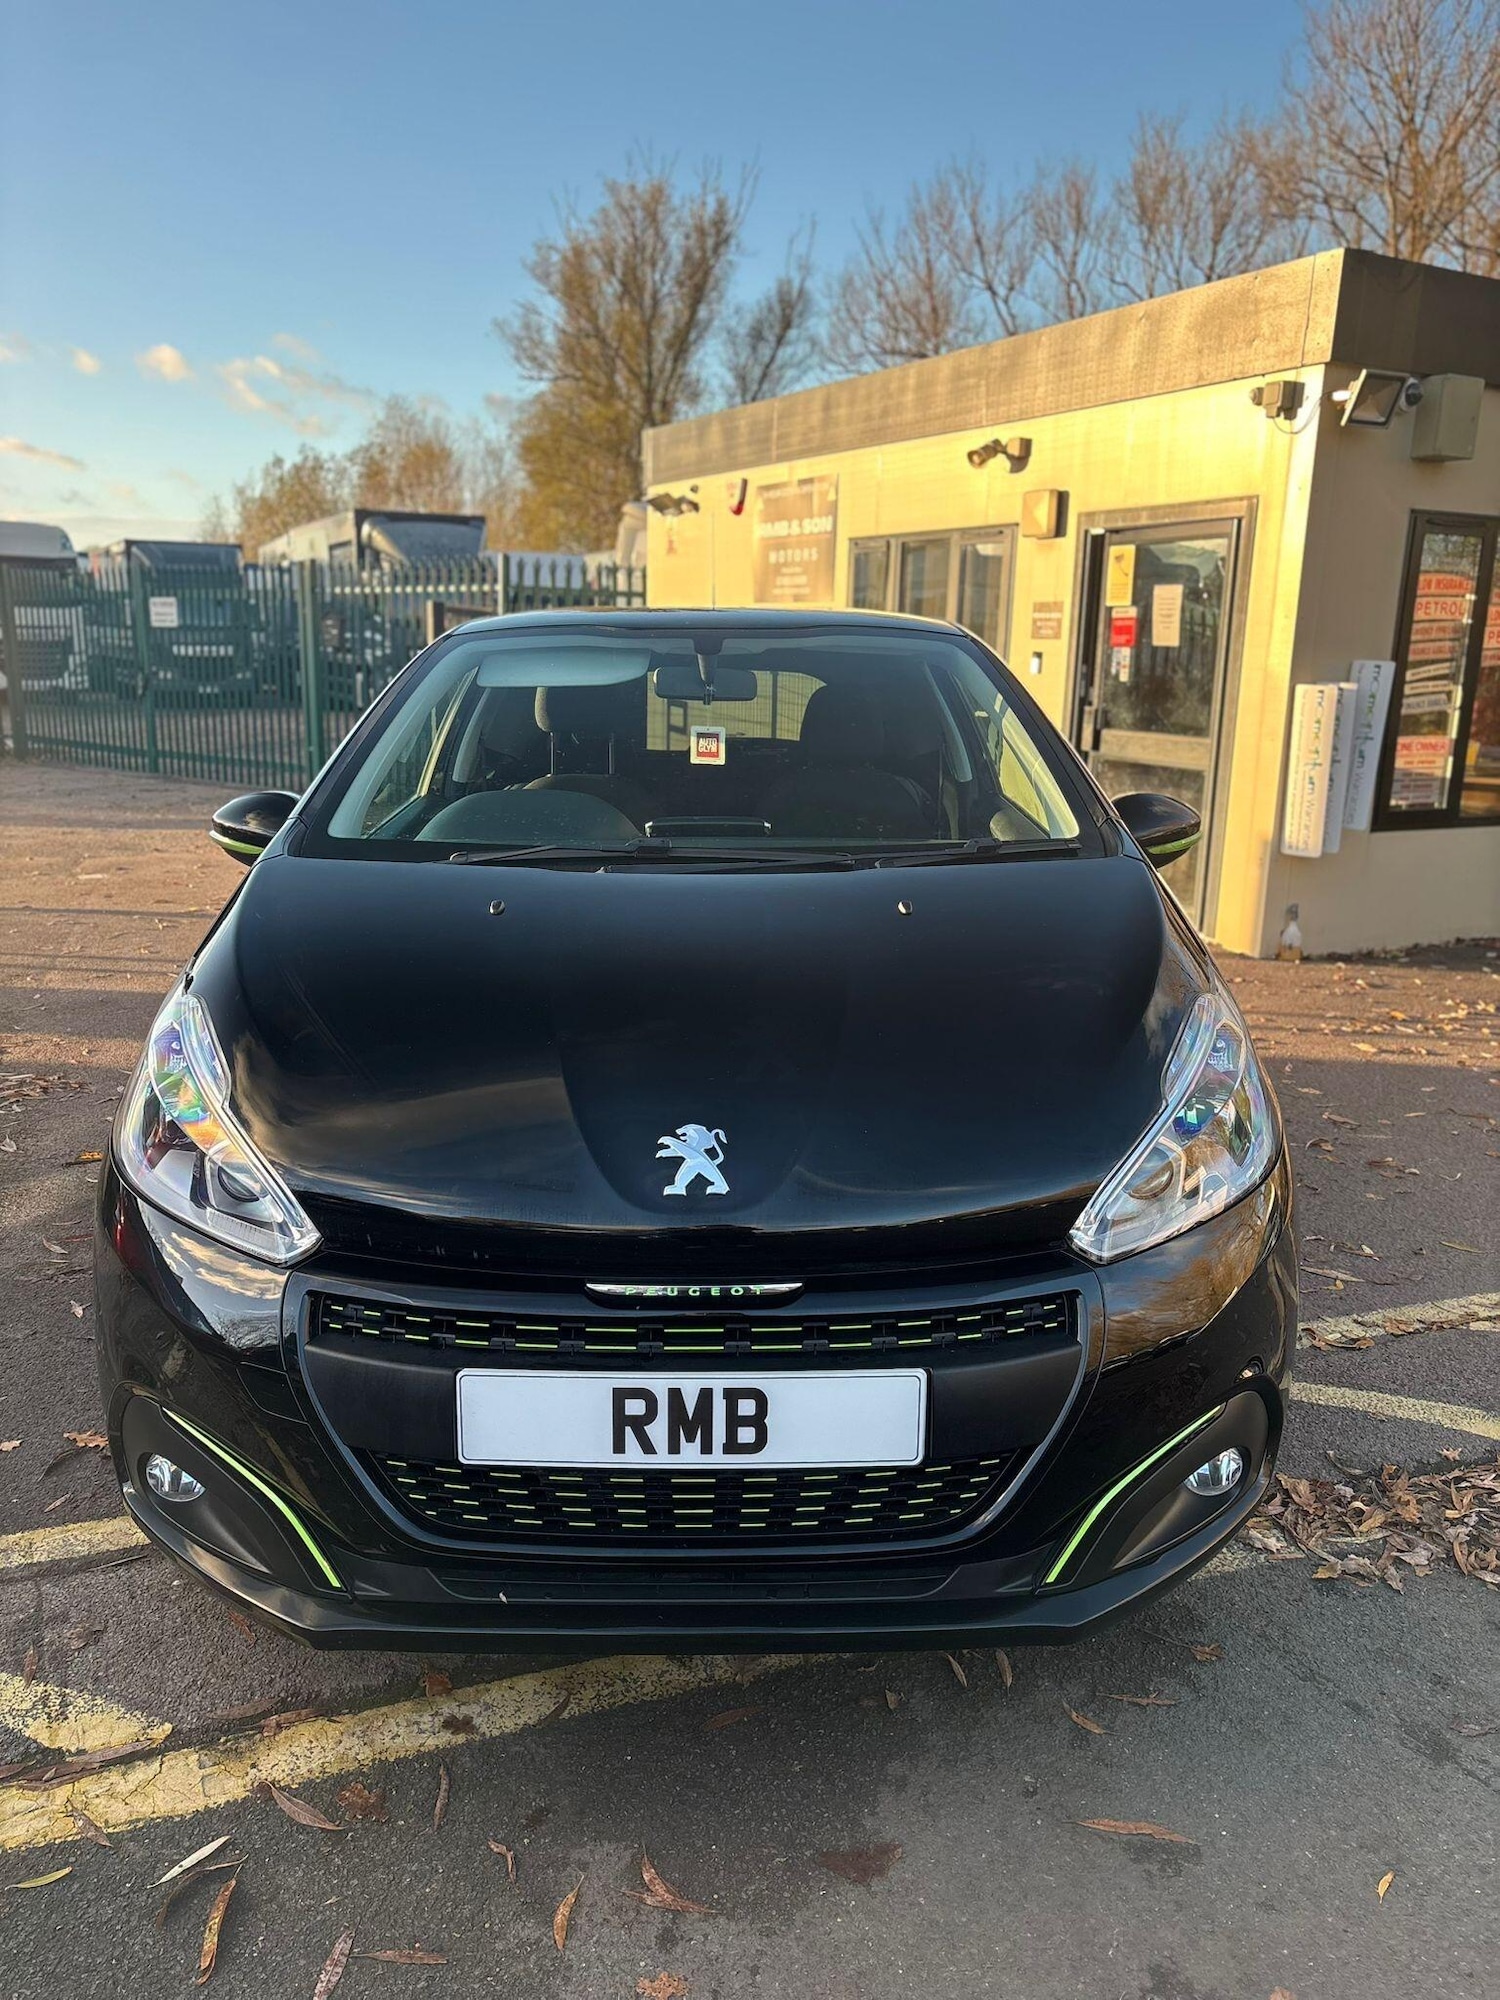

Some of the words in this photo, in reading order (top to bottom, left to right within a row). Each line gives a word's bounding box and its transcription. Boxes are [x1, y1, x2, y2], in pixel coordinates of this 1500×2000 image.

[802, 515, 833, 535] SON
[768, 547, 818, 564] MOTORS
[1416, 601, 1466, 617] PETROL
[1415, 740, 1447, 752] OWNER
[624, 1285, 765, 1297] PEUGEOT
[612, 1387, 769, 1455] RMB
